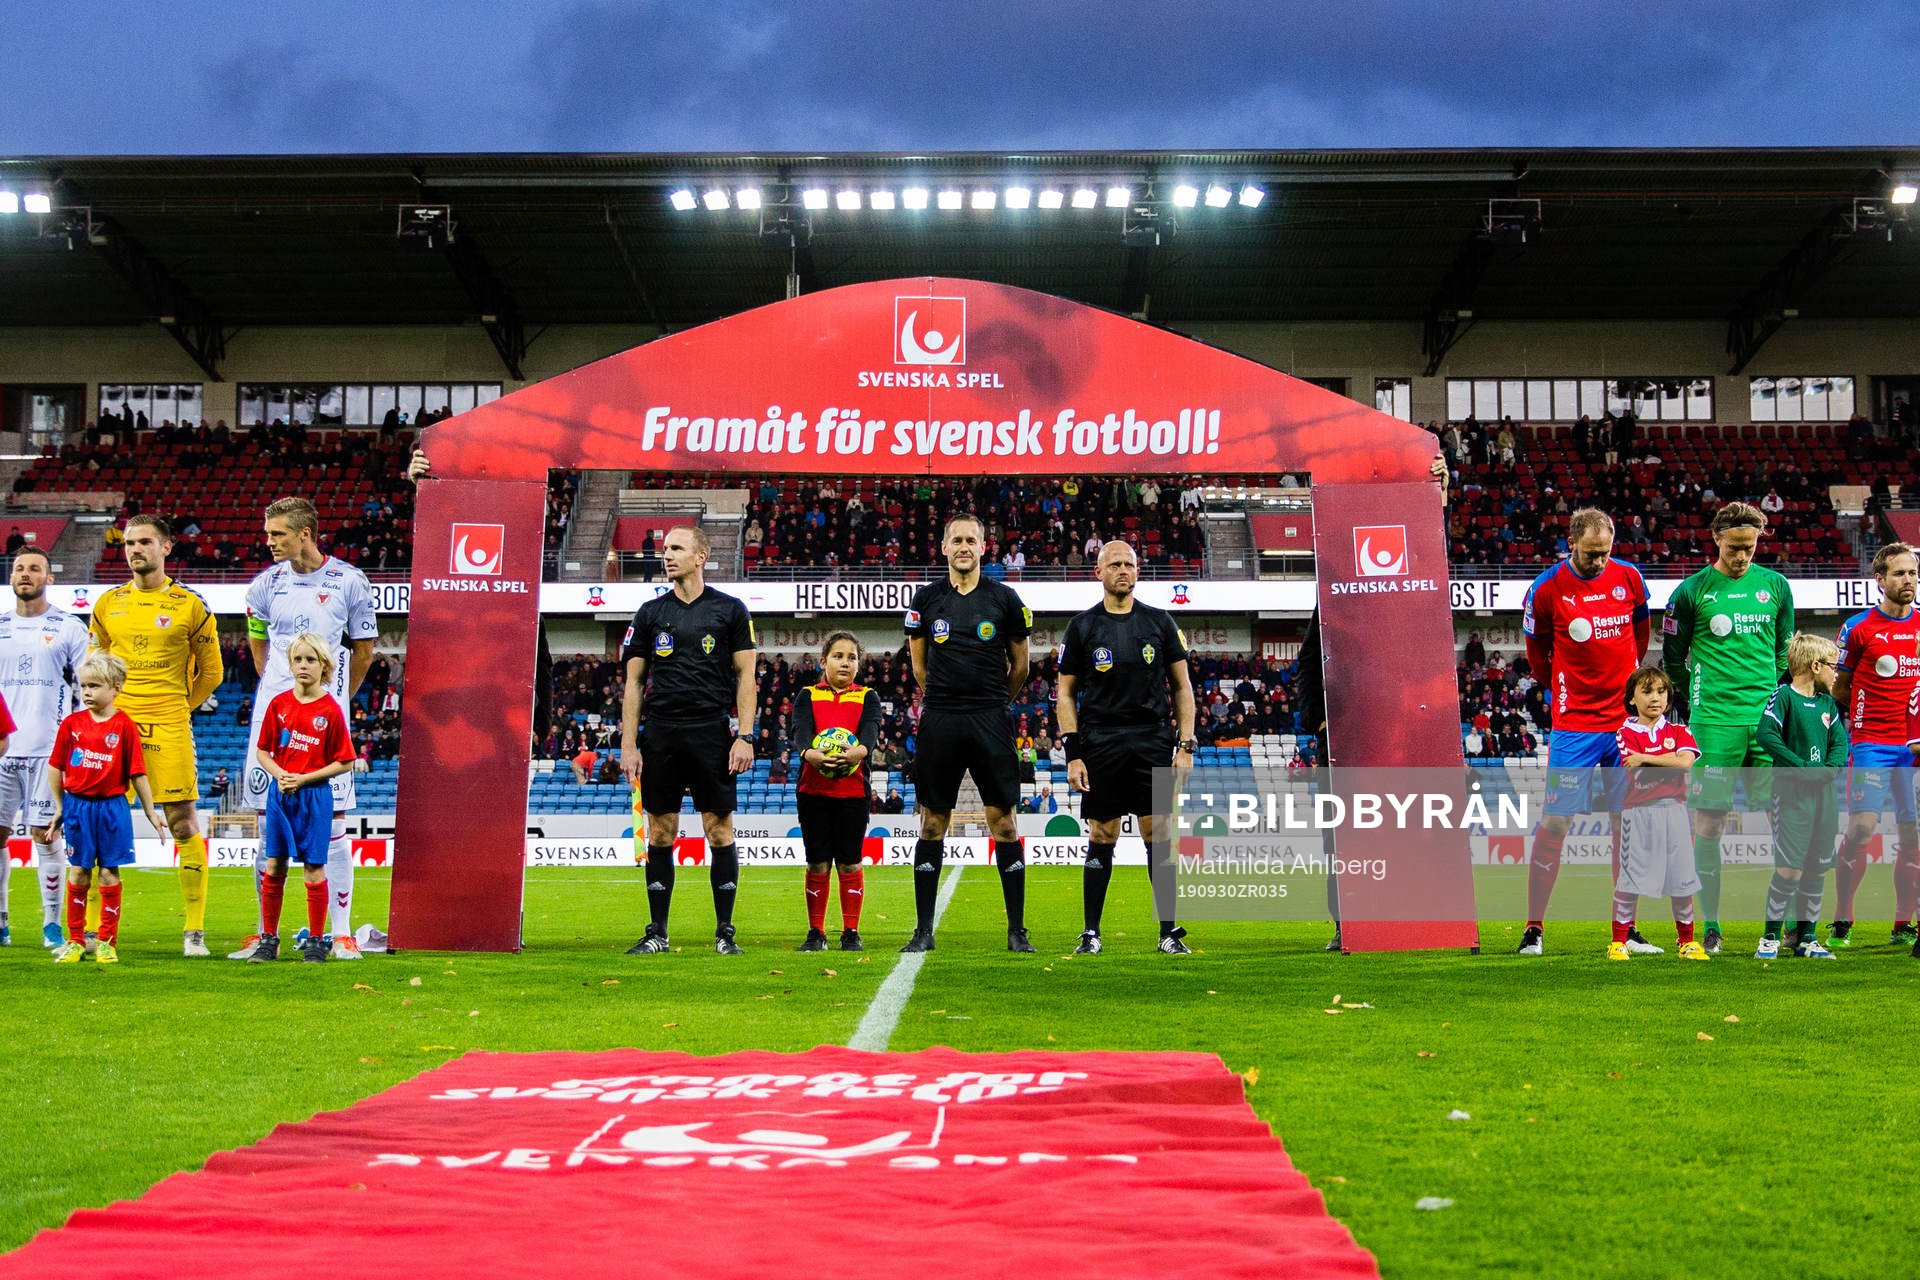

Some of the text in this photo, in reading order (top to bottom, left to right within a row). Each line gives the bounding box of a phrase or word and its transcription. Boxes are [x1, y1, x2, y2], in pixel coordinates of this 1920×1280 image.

[857, 371, 1004, 389] SVENSKA SPEL
[642, 405, 1221, 457] Framåt för svensk fotboll!
[422, 578, 529, 594] SVENSKA SPEL
[1331, 580, 1438, 595] SVENSKA SPEL
[796, 584, 926, 610] HELSINGBO
[1592, 614, 1630, 628] Resurs
[1733, 612, 1771, 623] Resurs
[1595, 626, 1621, 640] Bank
[1735, 623, 1762, 634] Bank
[1262, 642, 1304, 660] PUM
[336, 650, 345, 697] SCANIA
[1692, 676, 1701, 706] akea
[1853, 701, 1865, 729] akea
[288, 739, 309, 752] Bank
[291, 730, 321, 746] Resurs
[84, 749, 113, 762] Resurs
[82, 760, 103, 770] Bank
[1559, 774, 1578, 784] Solid
[534, 846, 618, 860] SVENSKA
[736, 845, 796, 860] ENSKA
